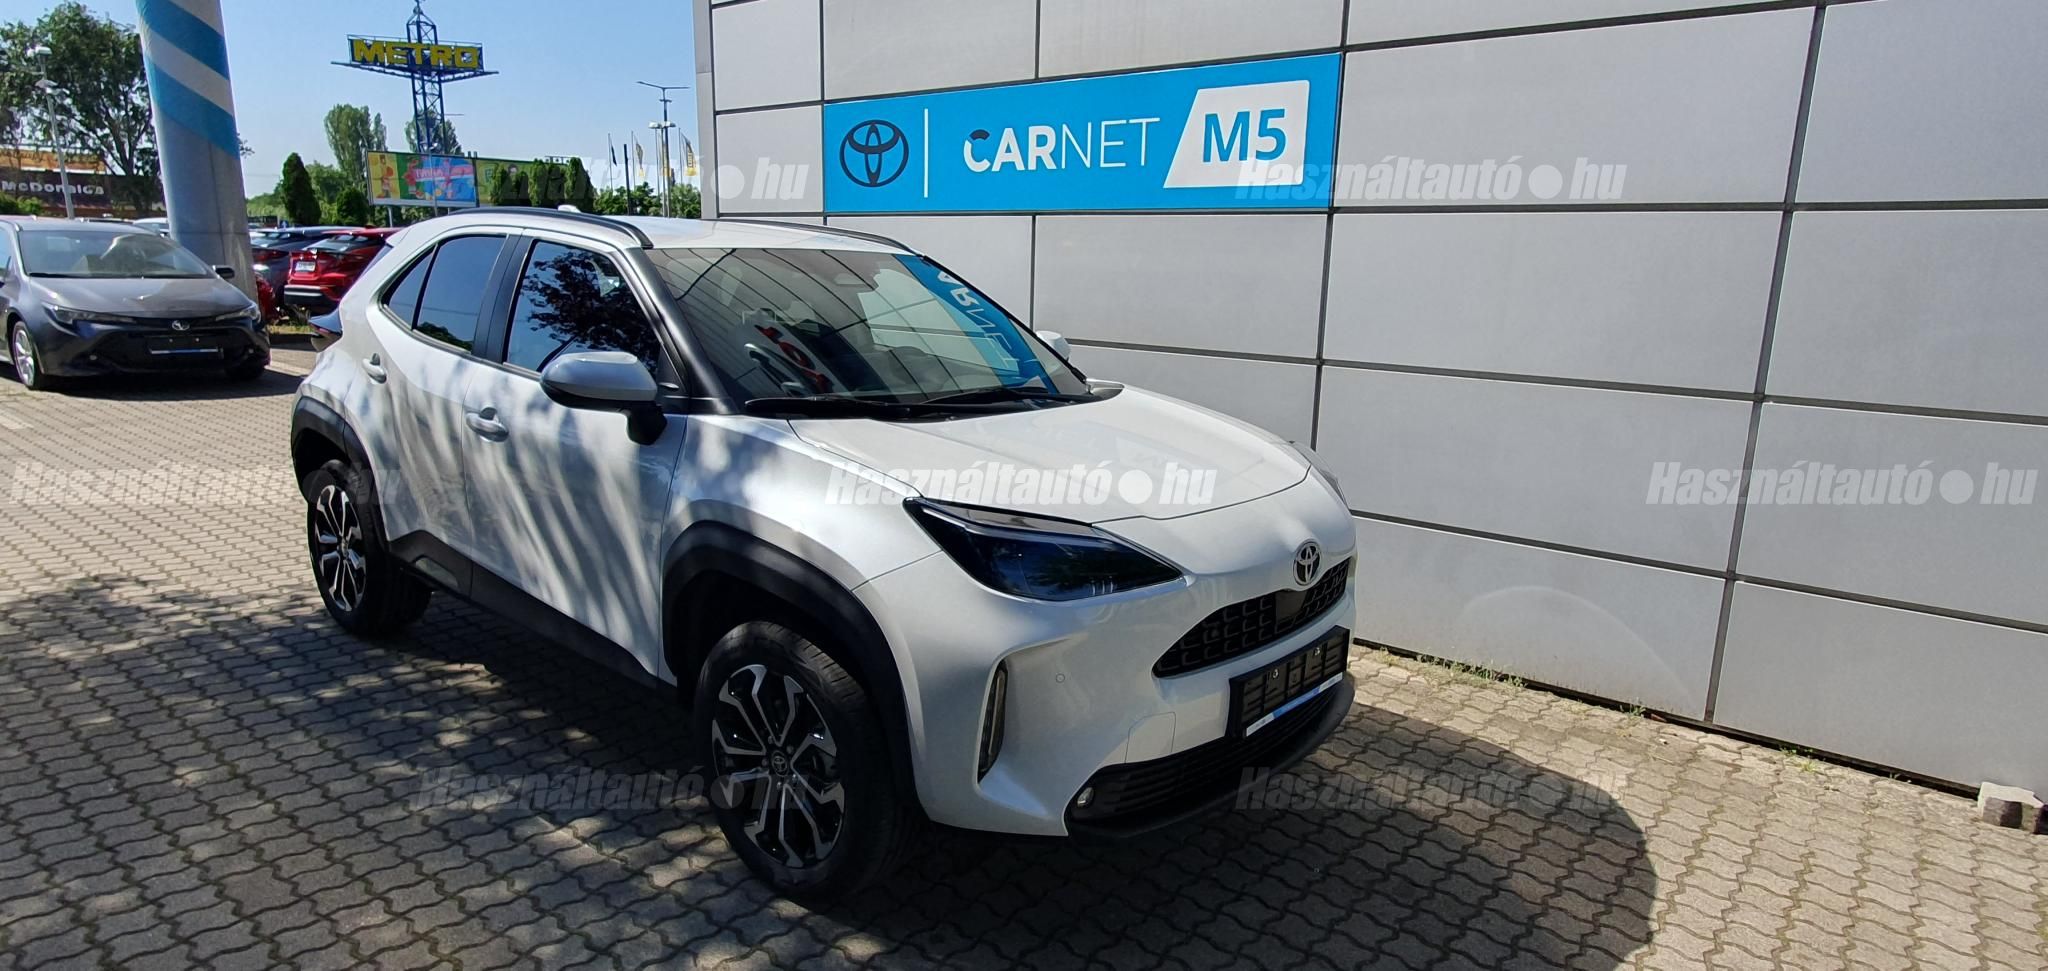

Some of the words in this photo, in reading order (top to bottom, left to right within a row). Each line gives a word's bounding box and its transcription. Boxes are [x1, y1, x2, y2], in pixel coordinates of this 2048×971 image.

[353, 38, 479, 68] METRO
[963, 117, 1160, 173] CARNET
[1202, 108, 1287, 163] M5
